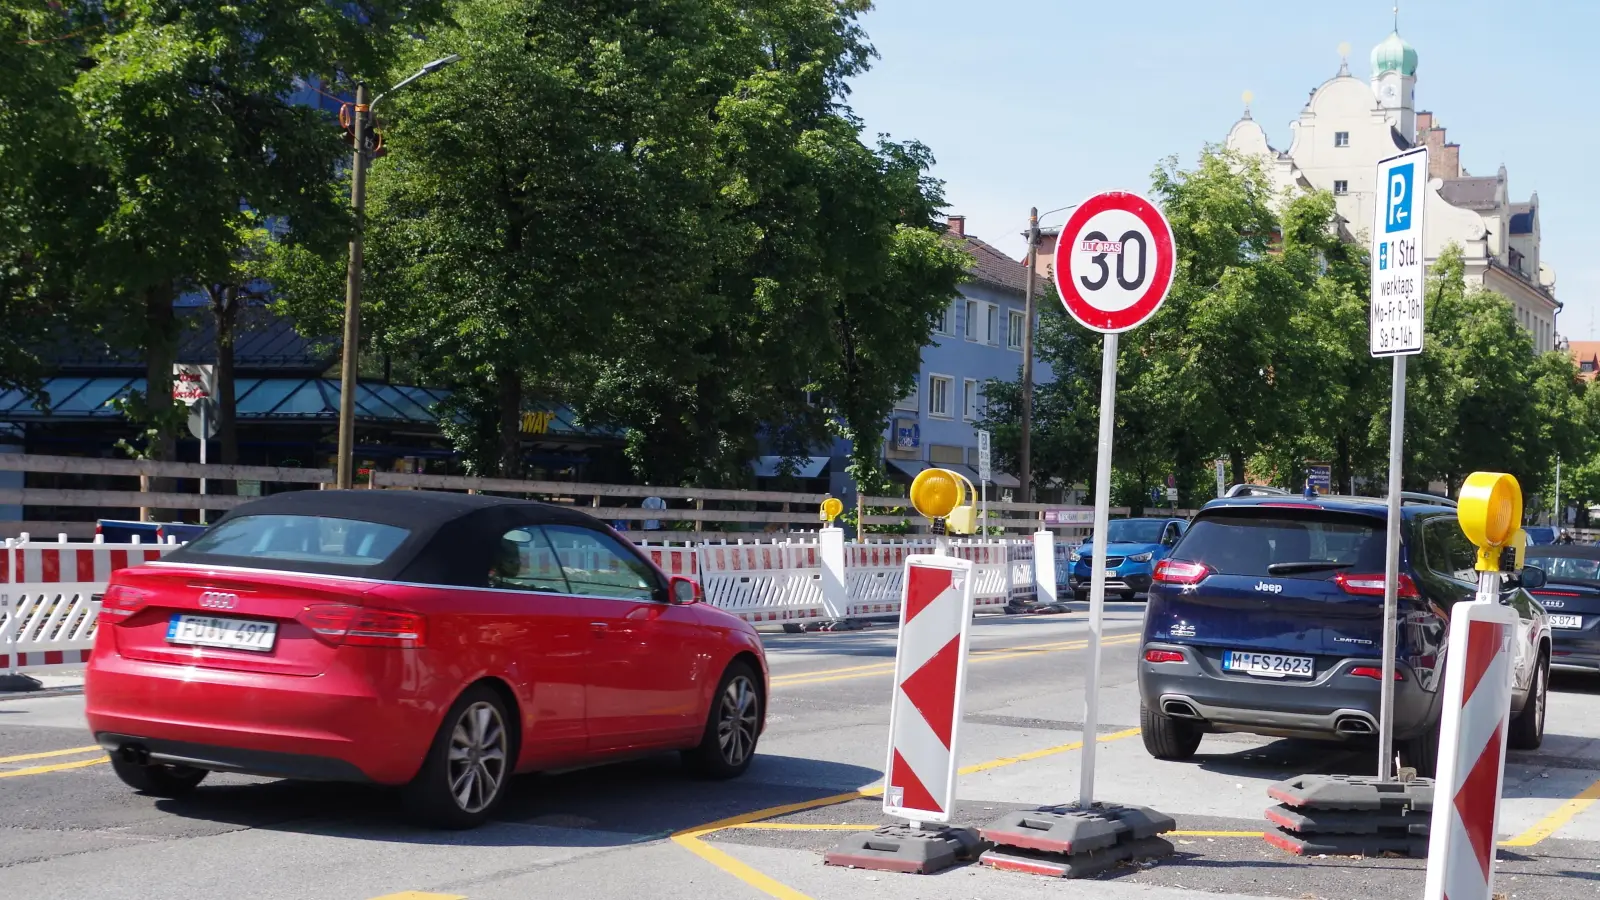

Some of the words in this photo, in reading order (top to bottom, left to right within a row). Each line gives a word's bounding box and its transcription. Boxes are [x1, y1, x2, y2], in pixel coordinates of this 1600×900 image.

[1389, 173, 1406, 225] P
[1080, 230, 1146, 291] 30
[1391, 241, 1395, 269] 1
[1399, 238, 1418, 267] Std.
[1380, 275, 1414, 299] werktags
[1374, 301, 1396, 323] Mo-Fr
[1380, 328, 1388, 348] Sa
[519, 411, 554, 434] WAY
[1254, 581, 1283, 594] Jeep
[1559, 616, 1577, 626] 871
[236, 623, 270, 644] 497
[1333, 637, 1373, 645] LIMITED
[1231, 653, 1242, 669] M
[1251, 655, 1271, 671] FS
[1274, 657, 1312, 674] 2623
